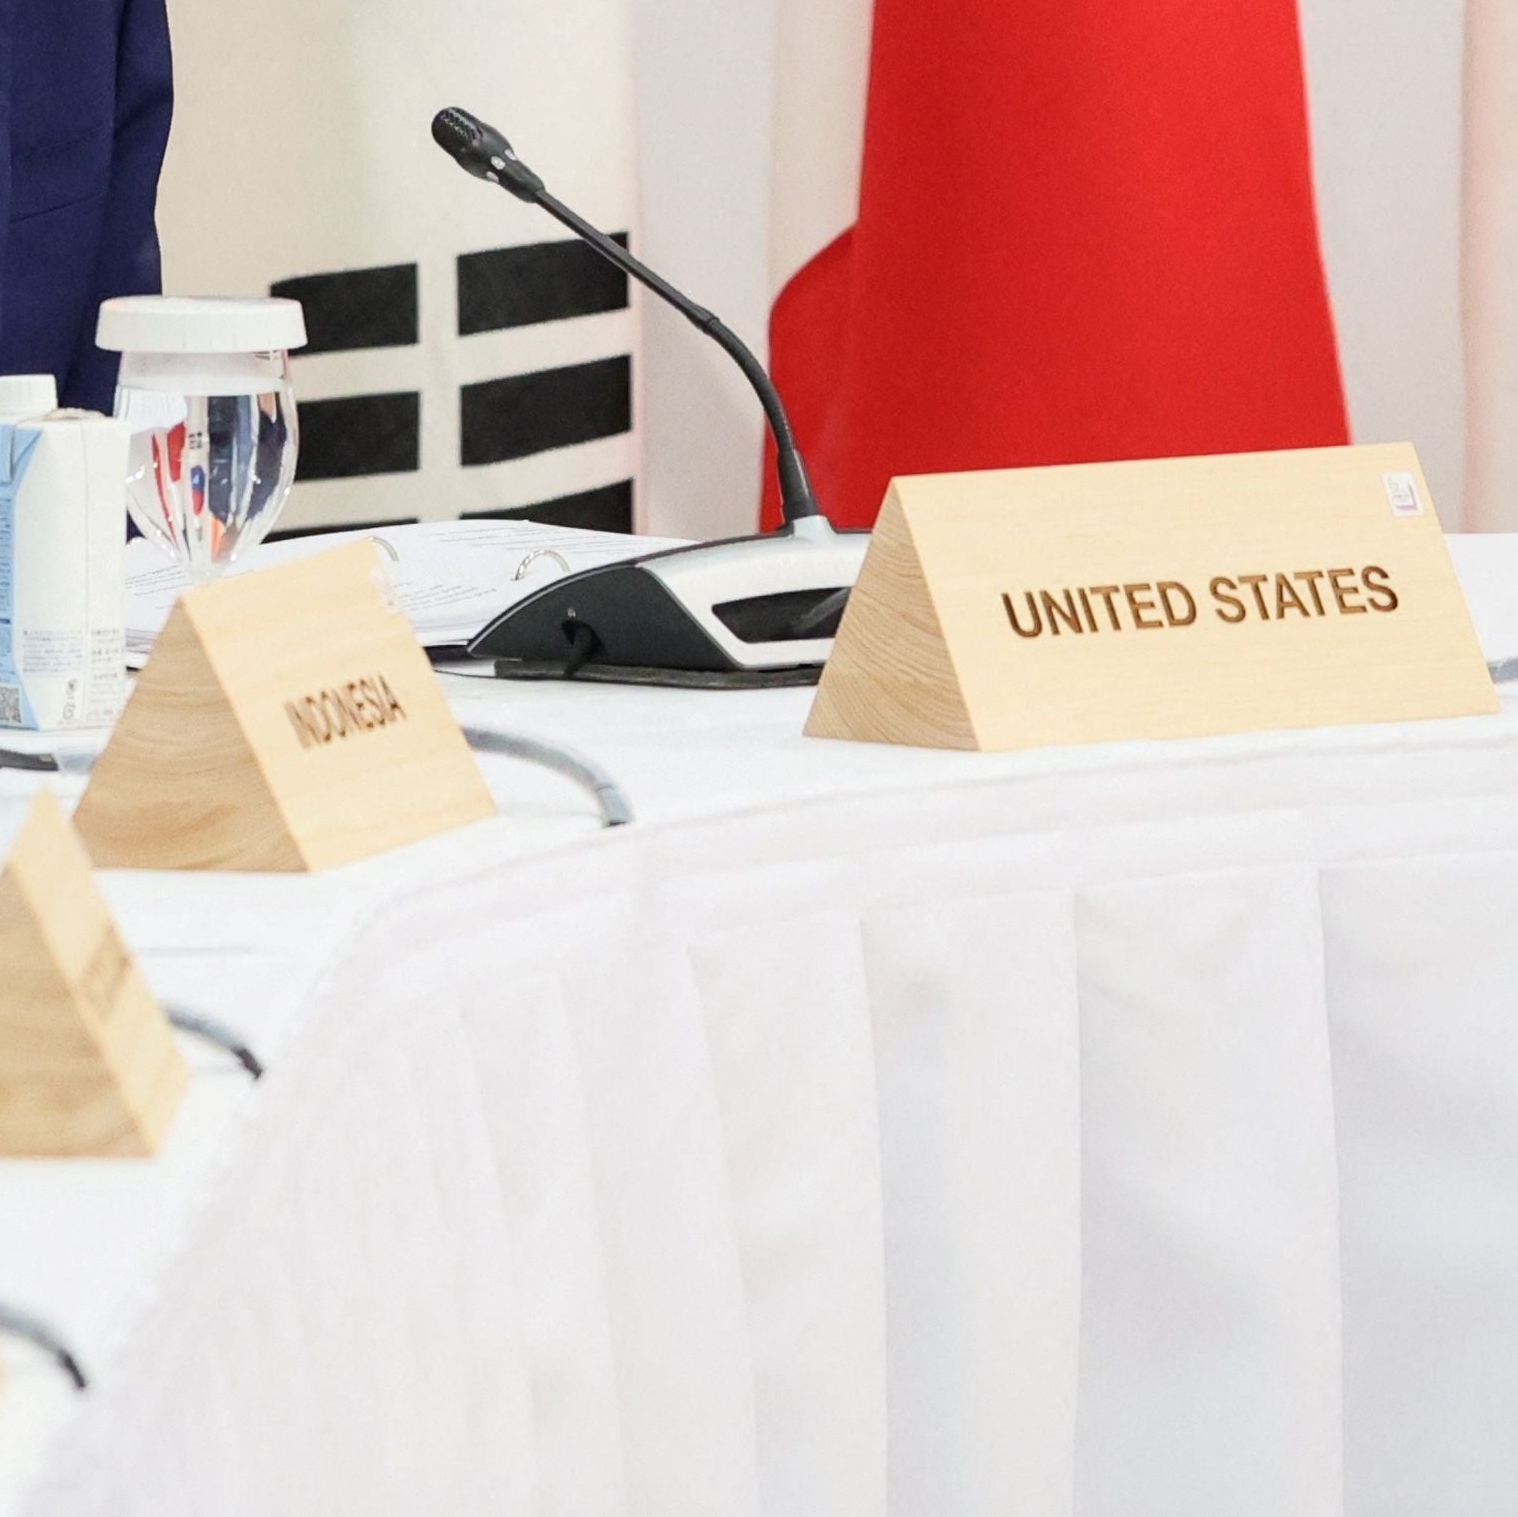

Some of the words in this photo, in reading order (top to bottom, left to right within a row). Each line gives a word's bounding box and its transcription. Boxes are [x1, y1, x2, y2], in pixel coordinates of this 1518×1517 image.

[1001, 580, 1198, 639] UNITED
[1208, 565, 1399, 624] STATES
[282, 672, 408, 750] INDONESIA
